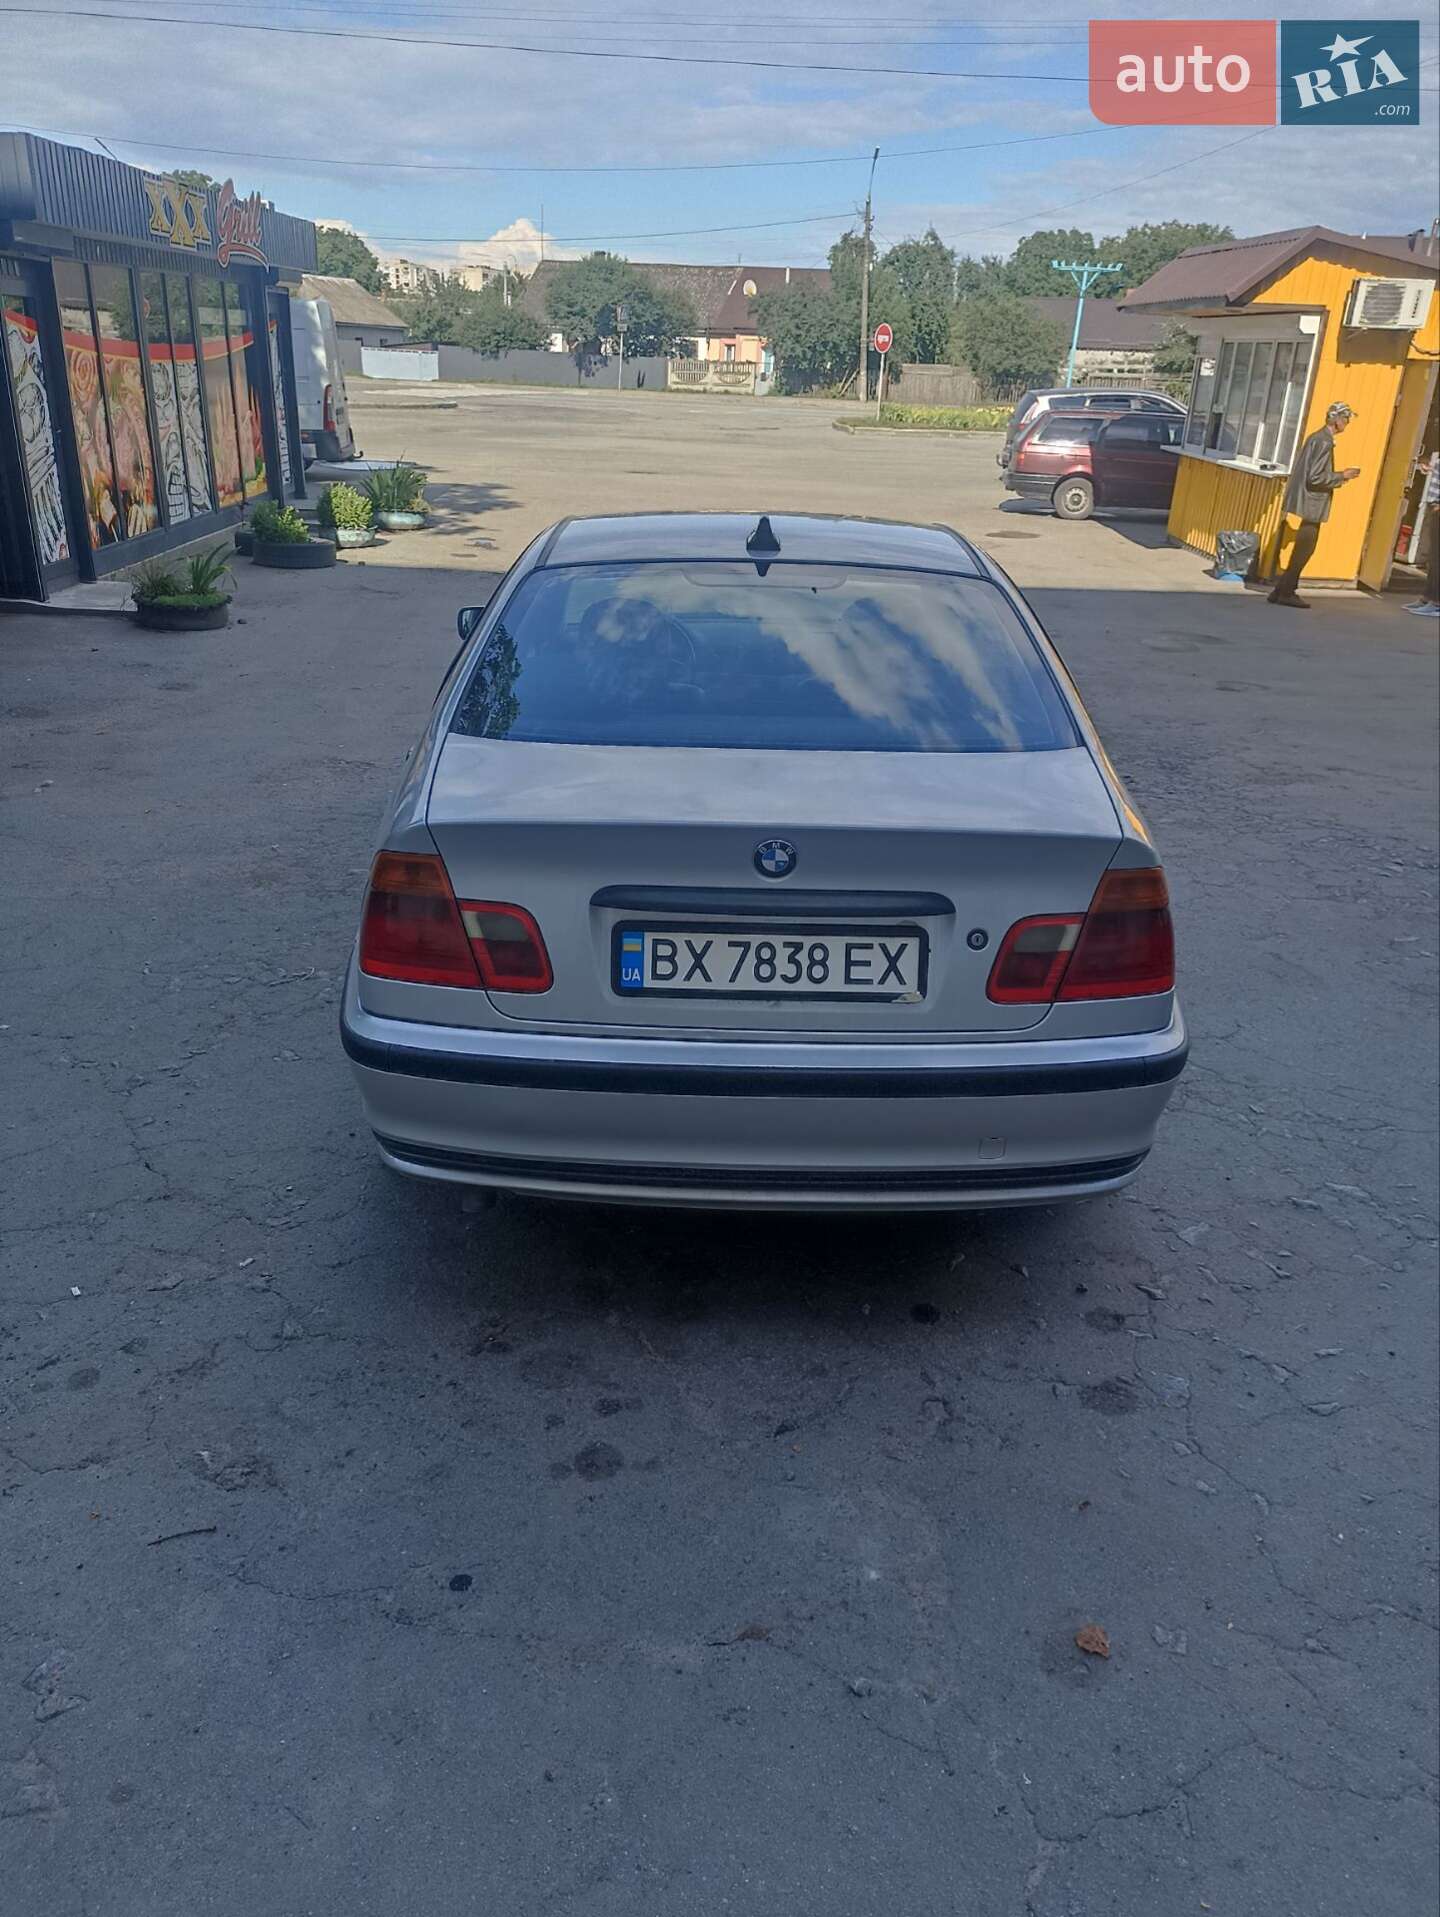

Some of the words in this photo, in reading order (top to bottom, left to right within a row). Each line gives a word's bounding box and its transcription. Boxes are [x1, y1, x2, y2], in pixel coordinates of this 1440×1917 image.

[143, 175, 211, 251] XXX
[622, 967, 641, 981] UA
[650, 938, 714, 982] BX
[727, 941, 830, 985] 7838
[844, 942, 909, 986] EX
